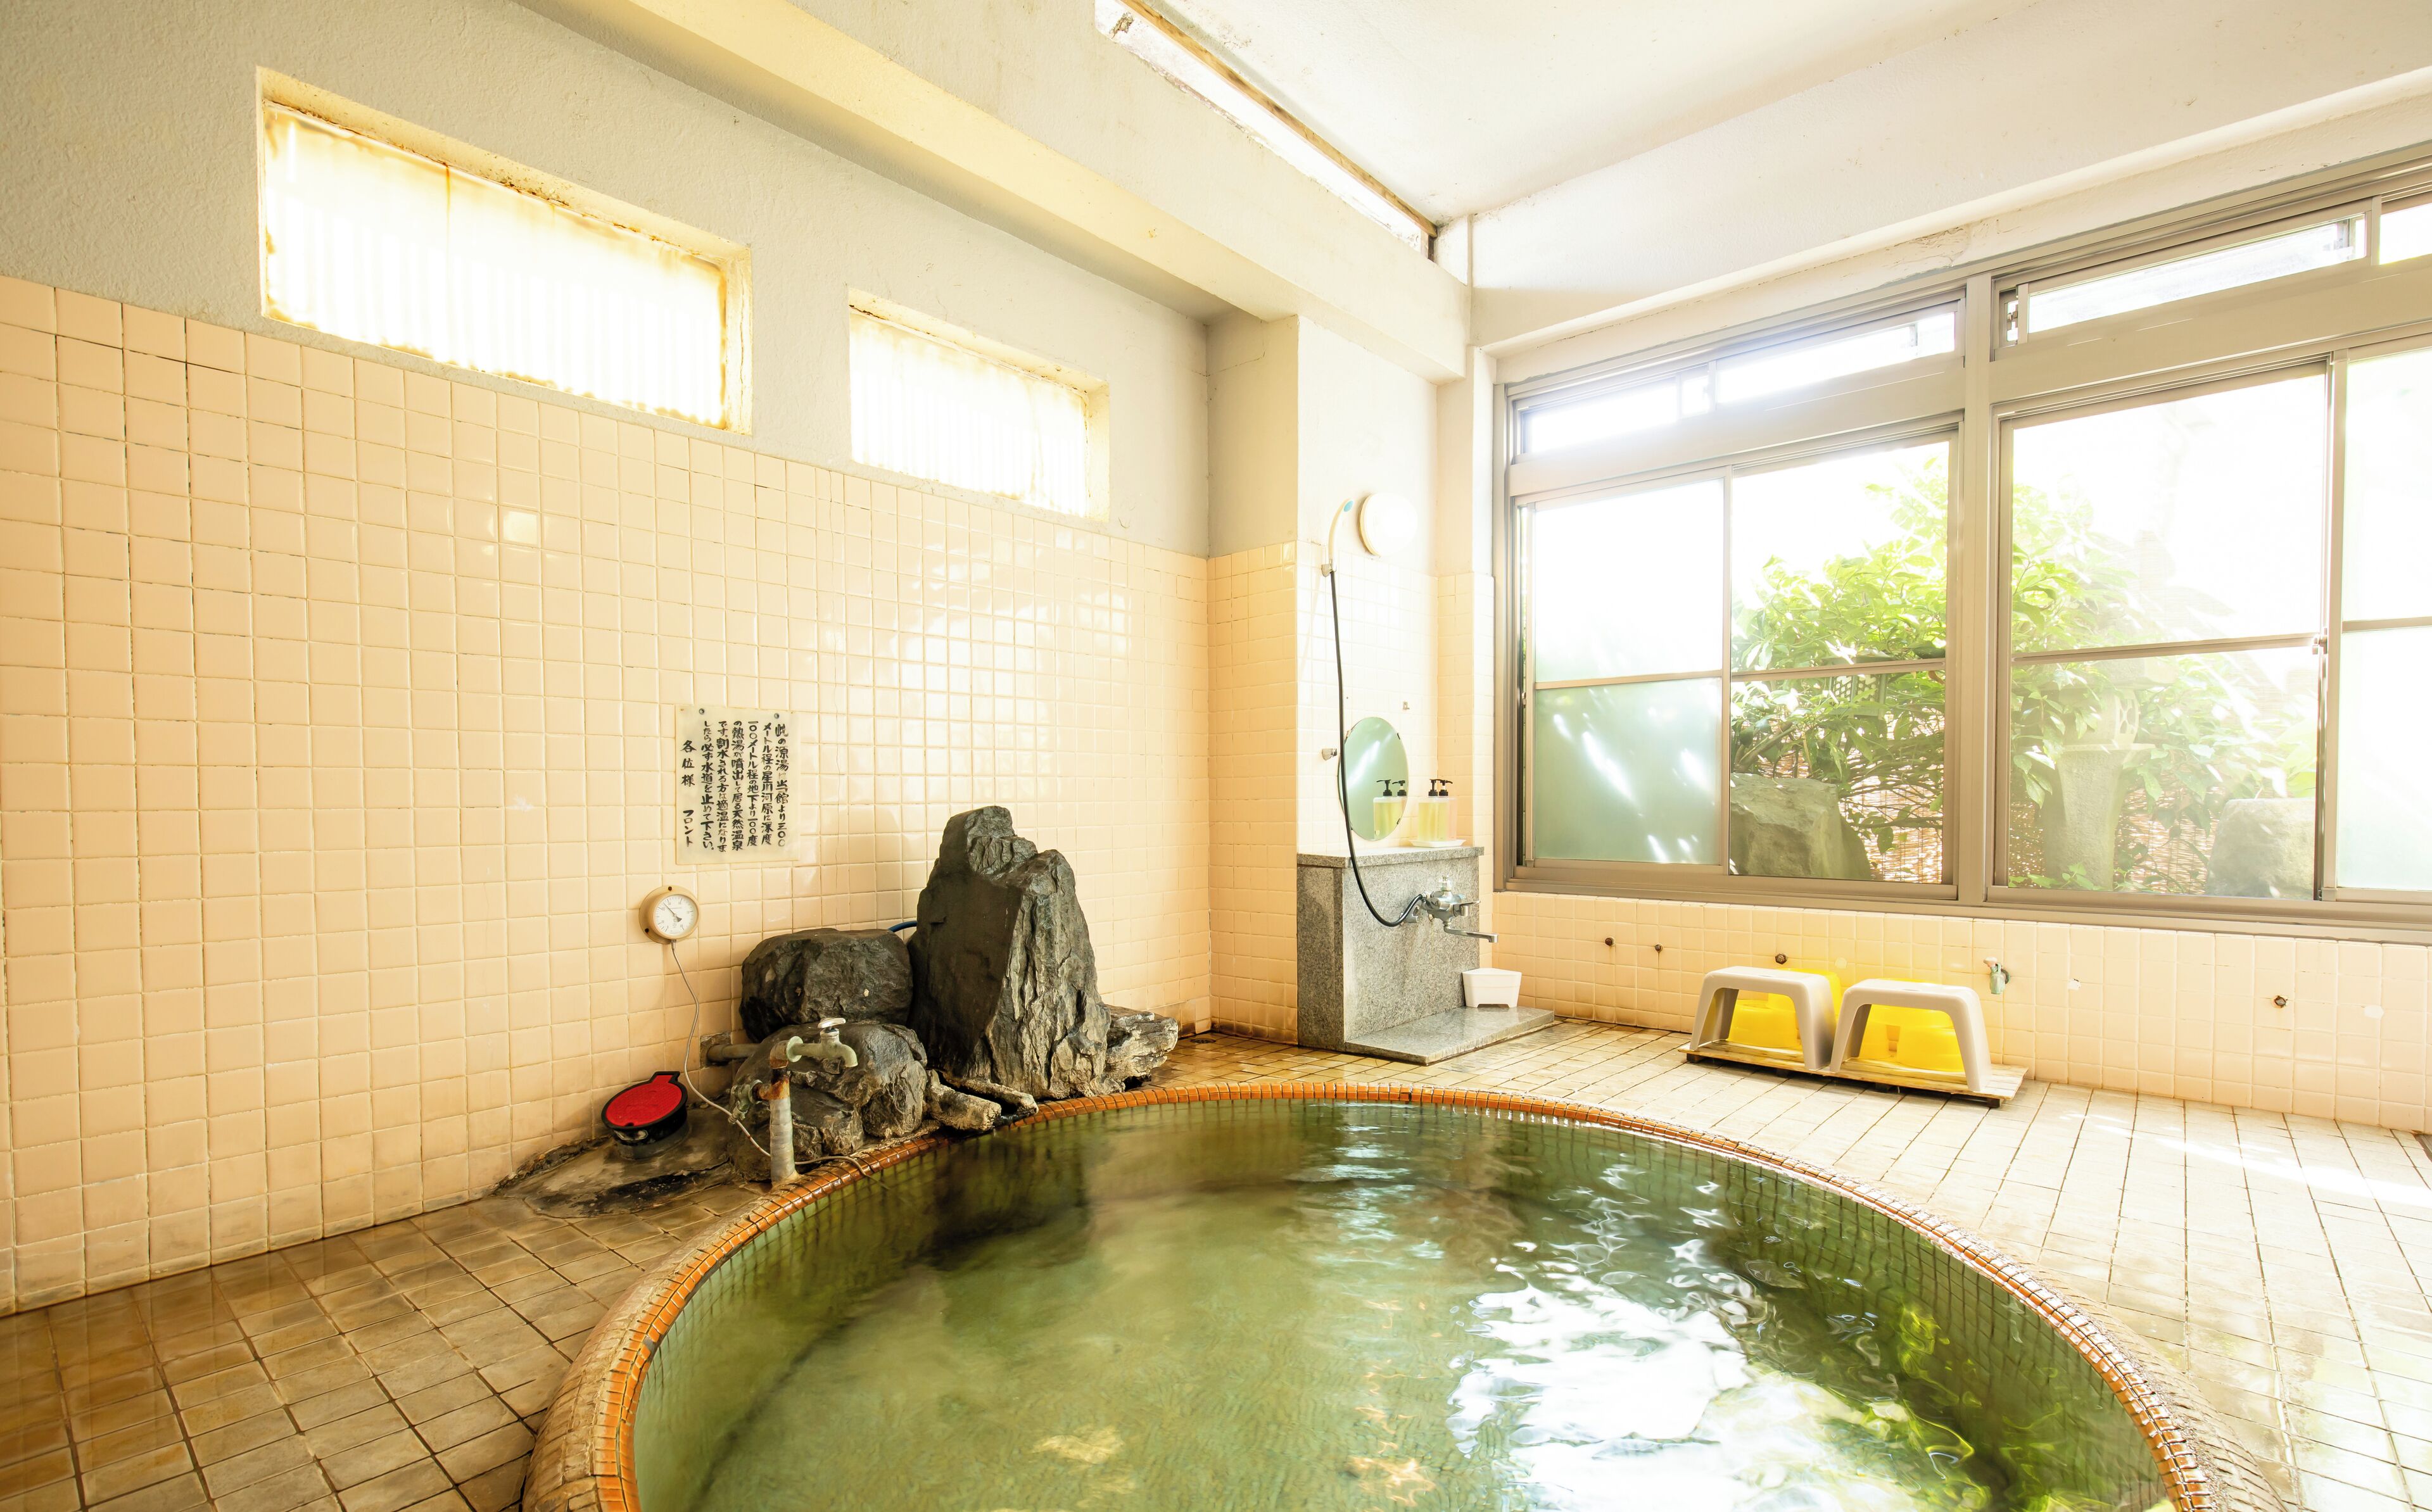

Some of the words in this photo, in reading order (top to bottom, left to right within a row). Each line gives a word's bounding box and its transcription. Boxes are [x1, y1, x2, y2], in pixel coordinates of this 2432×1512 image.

[680, 740, 697, 787] 各位様
[683, 809, 695, 847] フロント
